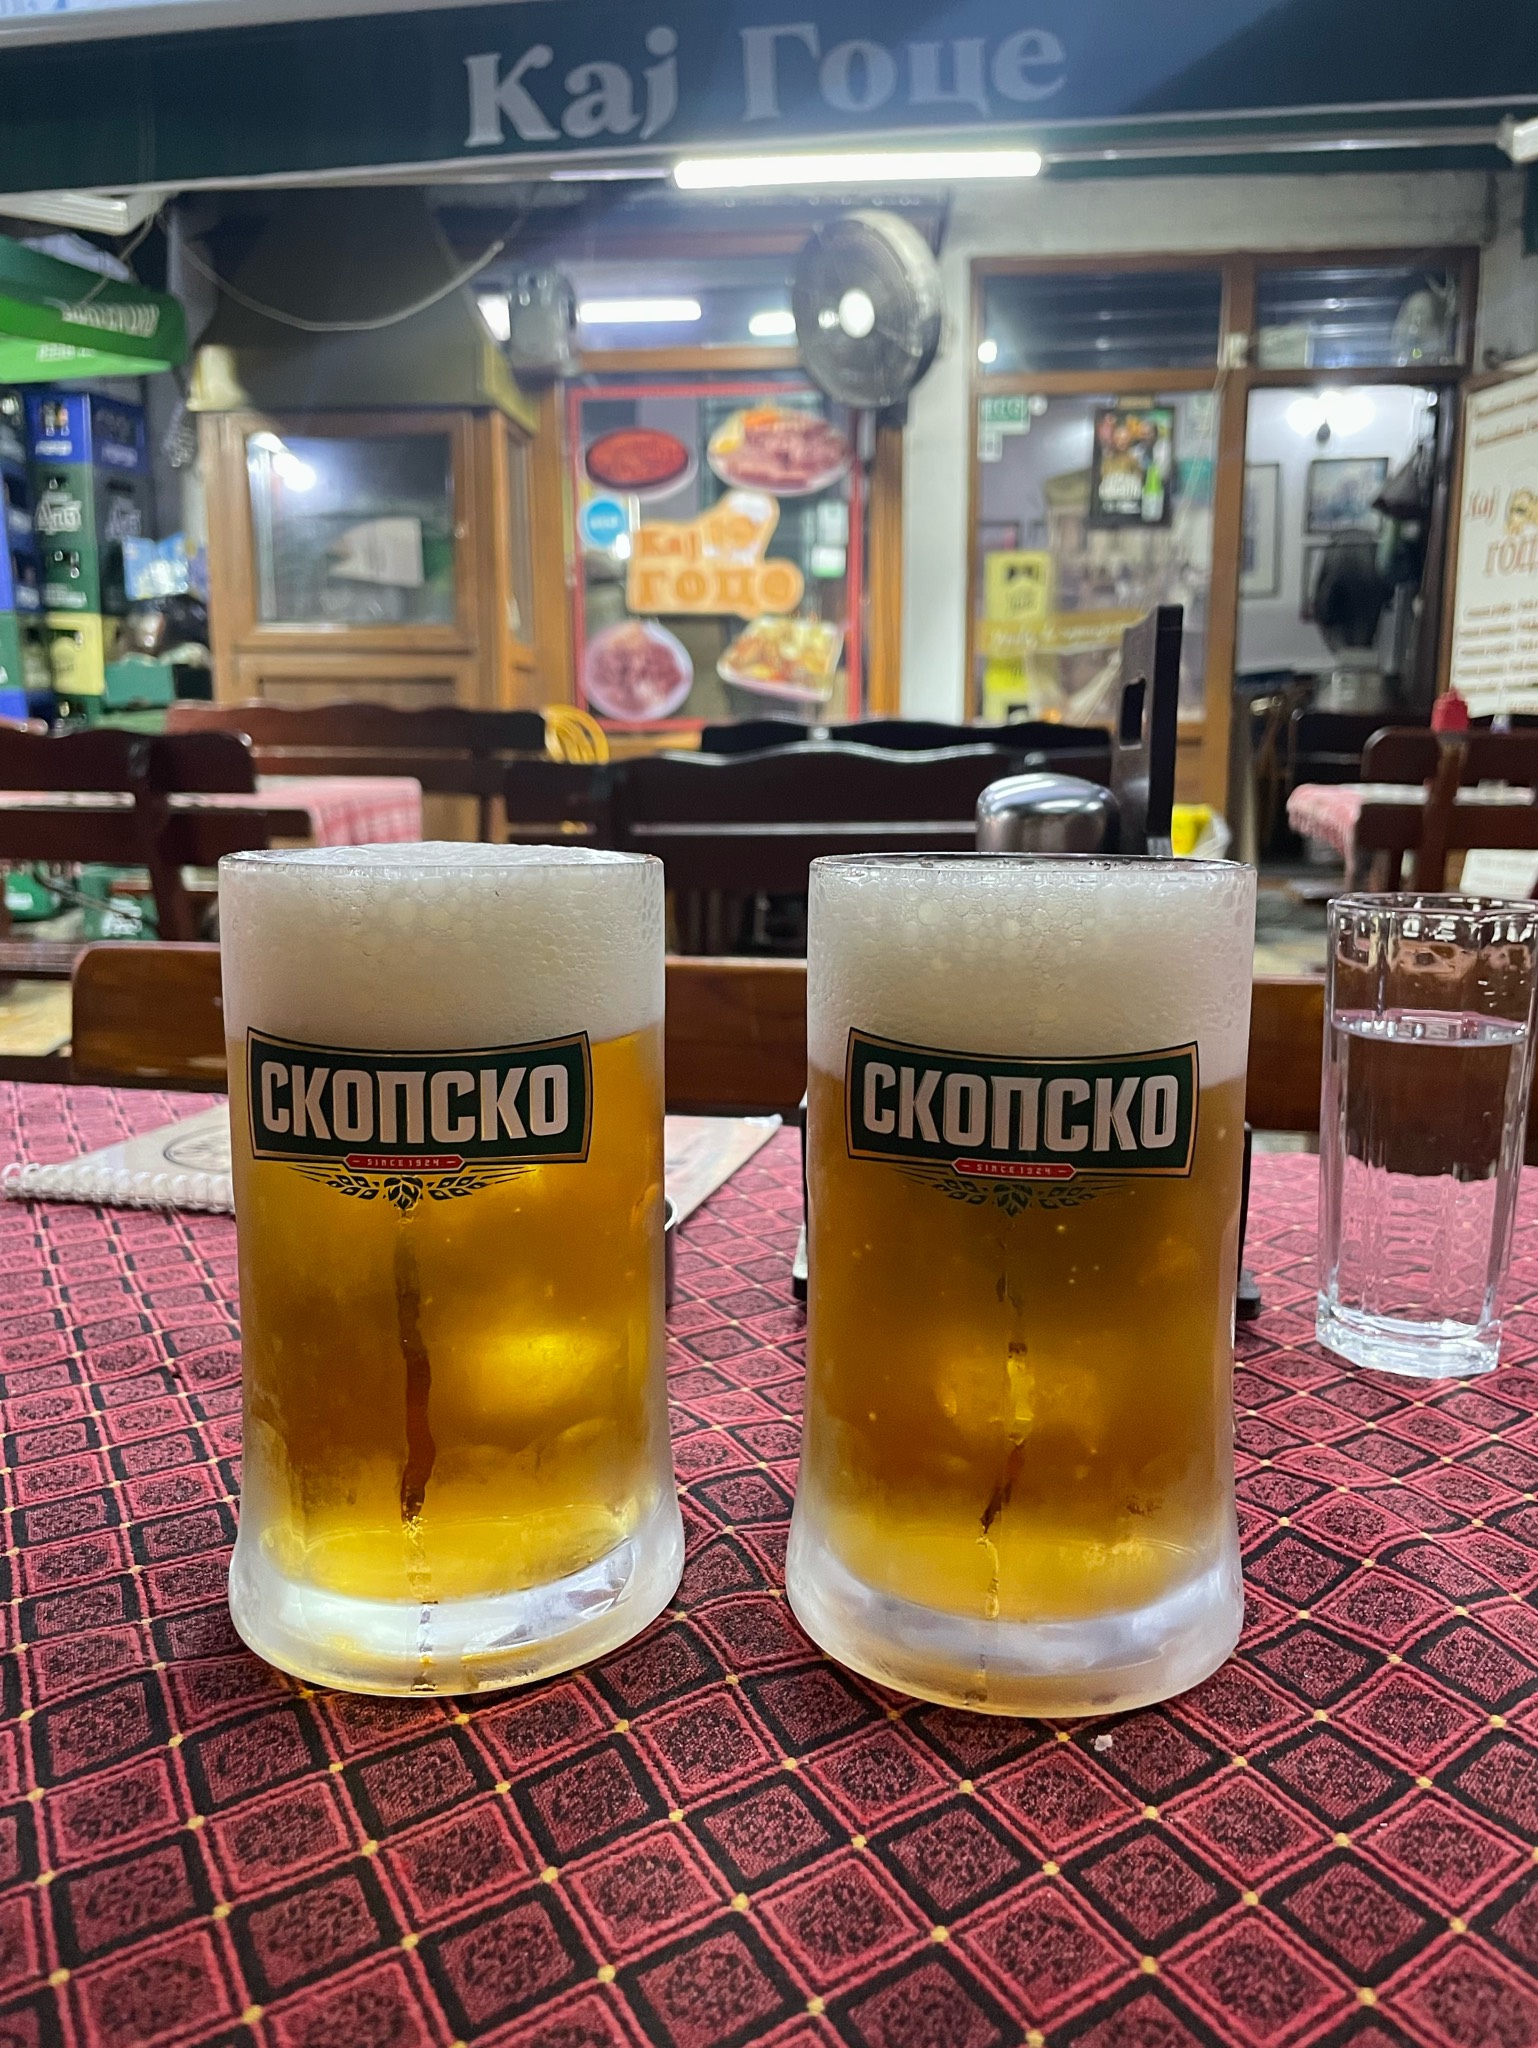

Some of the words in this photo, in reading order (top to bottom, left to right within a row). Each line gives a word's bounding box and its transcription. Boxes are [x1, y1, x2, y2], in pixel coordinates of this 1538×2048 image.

[463, 26, 679, 147] Кај
[740, 23, 1068, 120] Гоце
[261, 1060, 569, 1144] СКОПСКО
[863, 1061, 1179, 1152] СКОПСКО
[367, 1158, 404, 1167] SINCE
[408, 1158, 440, 1167] 1924
[976, 1163, 1015, 1174] SINCE
[1019, 1165, 1051, 1175] 1924
